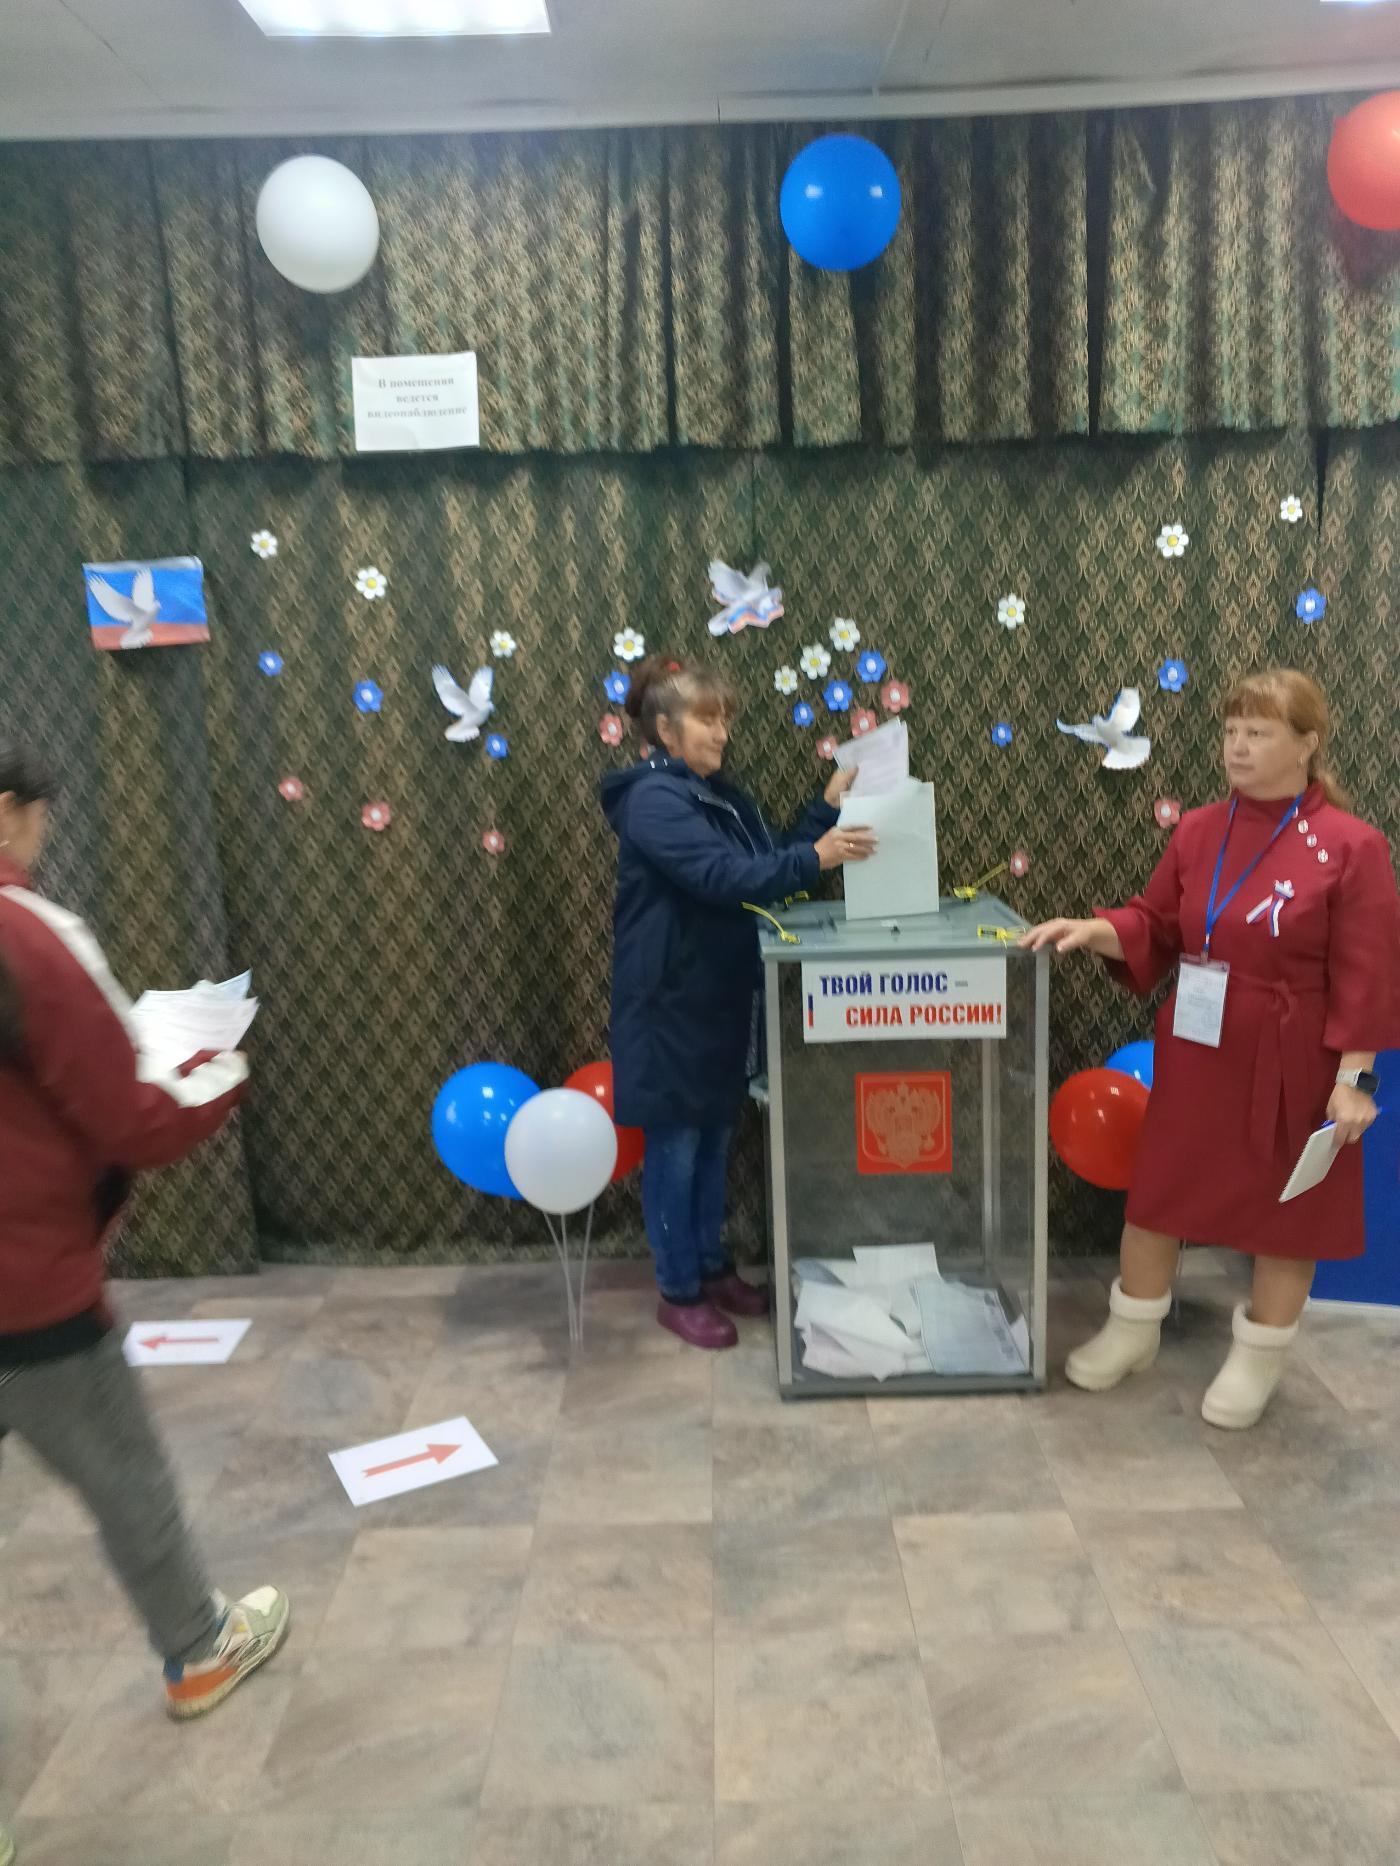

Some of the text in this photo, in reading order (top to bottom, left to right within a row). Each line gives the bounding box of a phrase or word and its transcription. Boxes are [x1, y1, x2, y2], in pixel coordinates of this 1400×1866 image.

[378, 379, 387, 389] В
[819, 971, 872, 996] ТВОЙ
[879, 972, 948, 995] ГОЛОС
[845, 1004, 1001, 1028] СИЛА РОССИИ!
